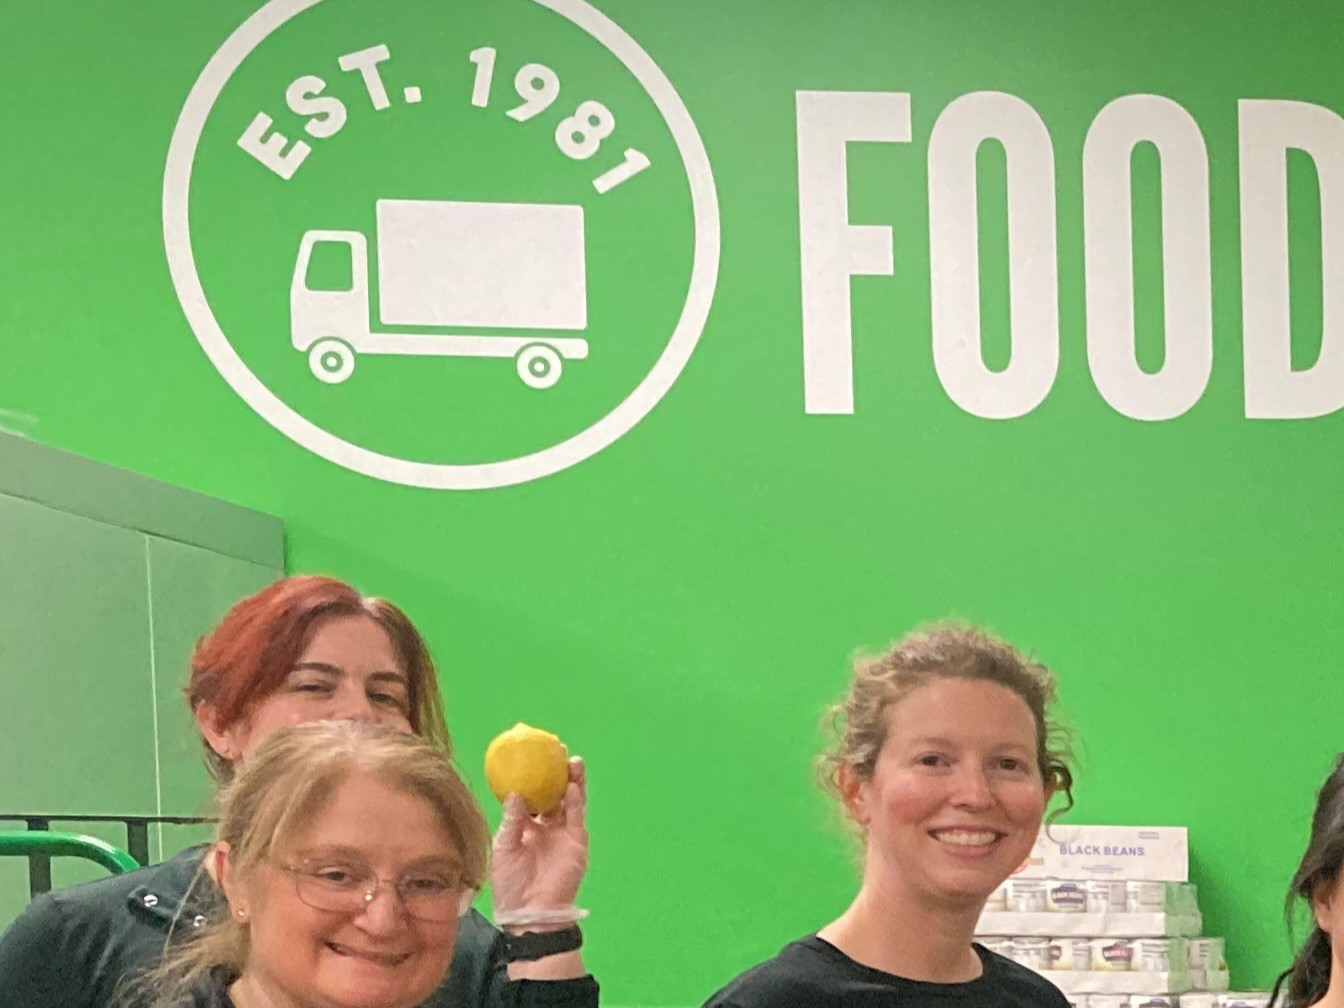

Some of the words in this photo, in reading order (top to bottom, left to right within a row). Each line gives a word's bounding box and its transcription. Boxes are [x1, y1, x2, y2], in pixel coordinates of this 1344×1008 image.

[237, 43, 422, 181] EST.
[469, 46, 651, 194] 1981
[1060, 844, 1101, 856] BLACK
[1103, 846, 1145, 857] BEANS
